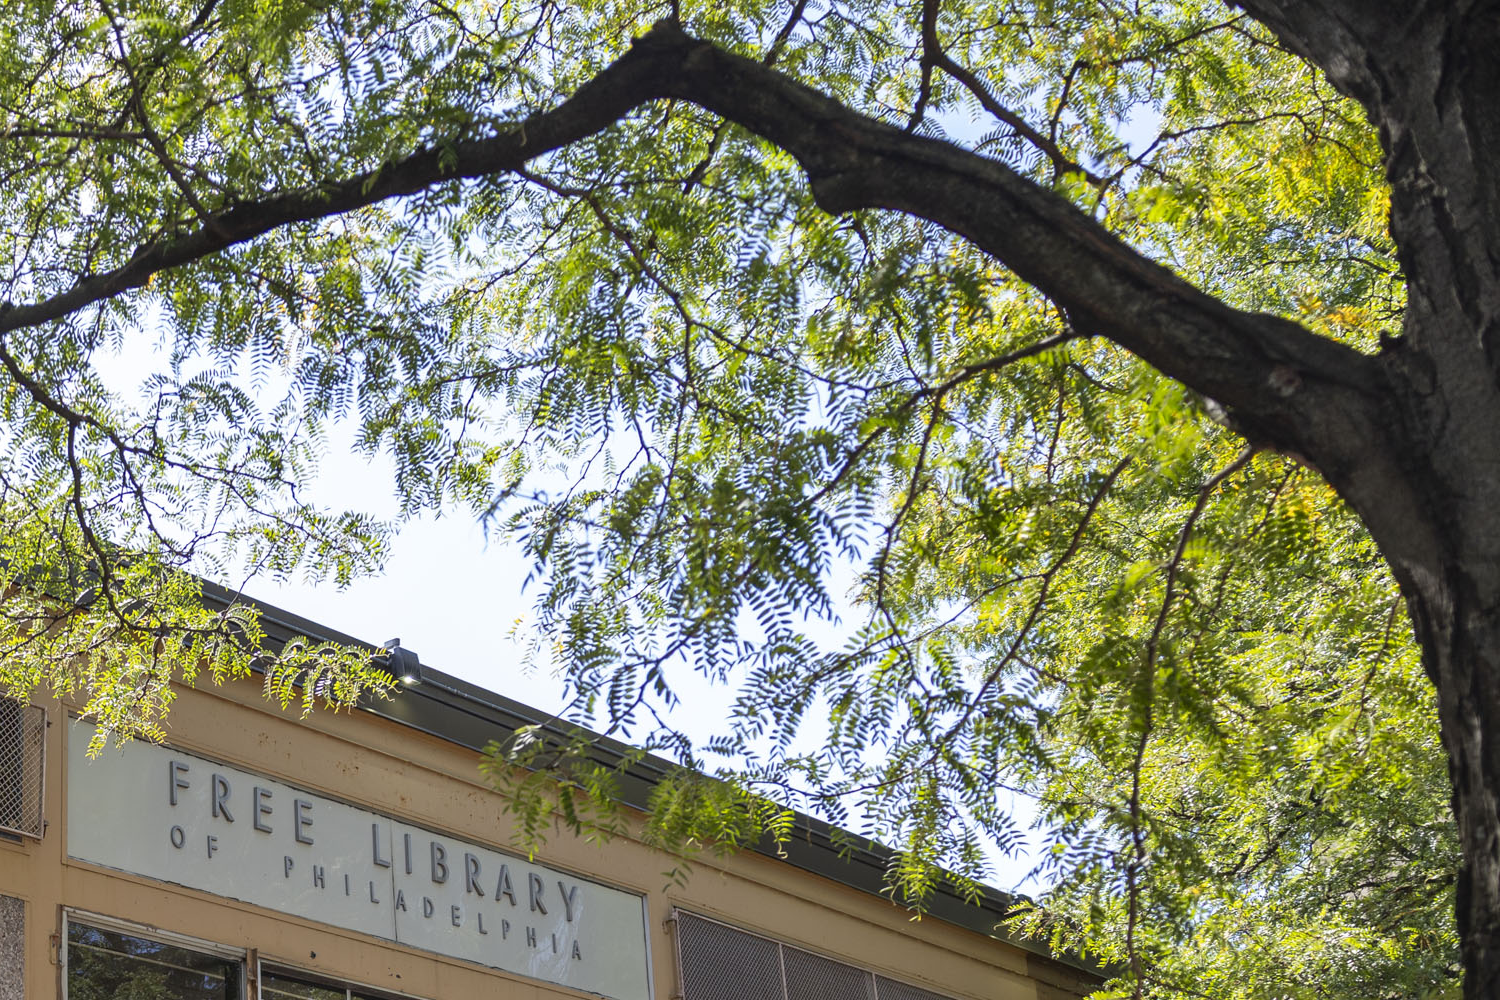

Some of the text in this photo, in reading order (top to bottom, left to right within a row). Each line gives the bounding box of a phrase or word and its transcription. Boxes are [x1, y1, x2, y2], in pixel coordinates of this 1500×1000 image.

[169, 760, 581, 923] FREE LIBRARY
[169, 824, 583, 962] OF PHILADELPHIA
